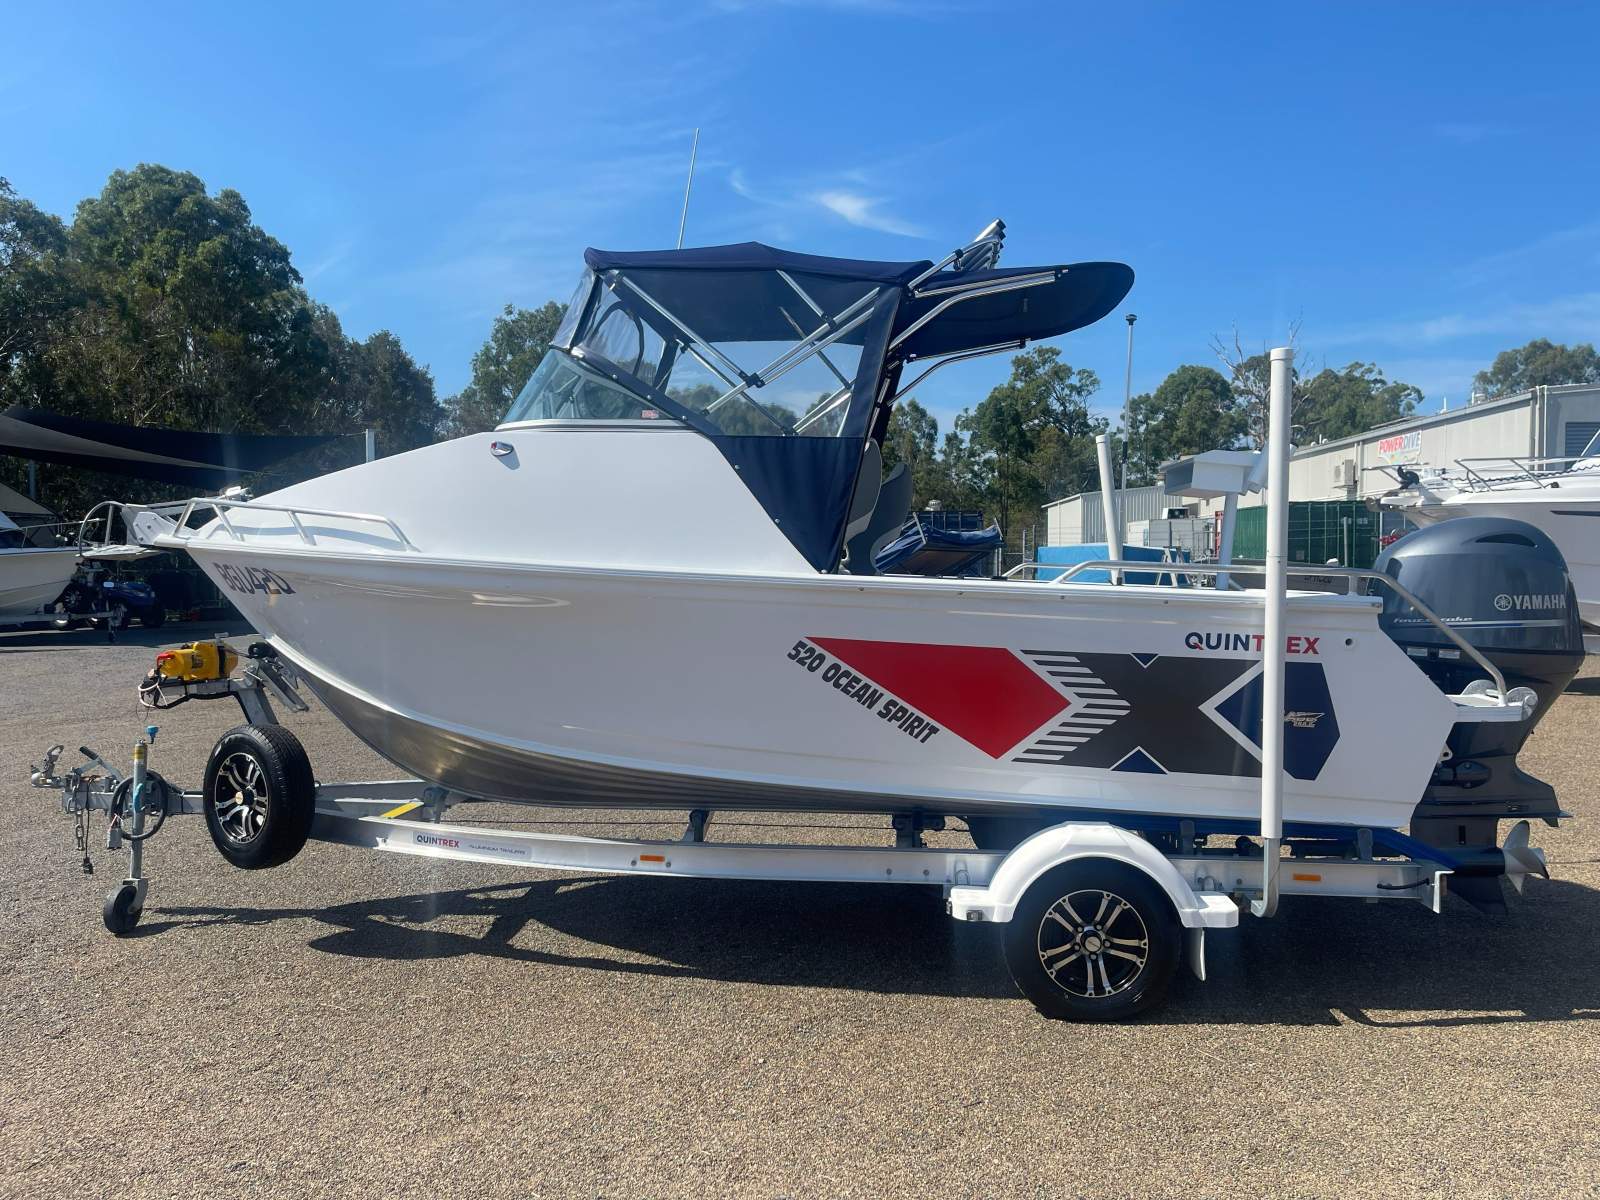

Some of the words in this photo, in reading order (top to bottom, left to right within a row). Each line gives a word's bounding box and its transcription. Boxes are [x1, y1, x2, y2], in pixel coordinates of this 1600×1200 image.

[1379, 431, 1420, 454] POWERDIVE
[1514, 594, 1567, 610] YAMAHA
[1185, 632, 1320, 655] QUINTEX
[787, 640, 826, 673] 520
[822, 663, 884, 710] OCEAN
[876, 699, 940, 744] SPIRIT
[416, 835, 460, 848] QUINTREX
